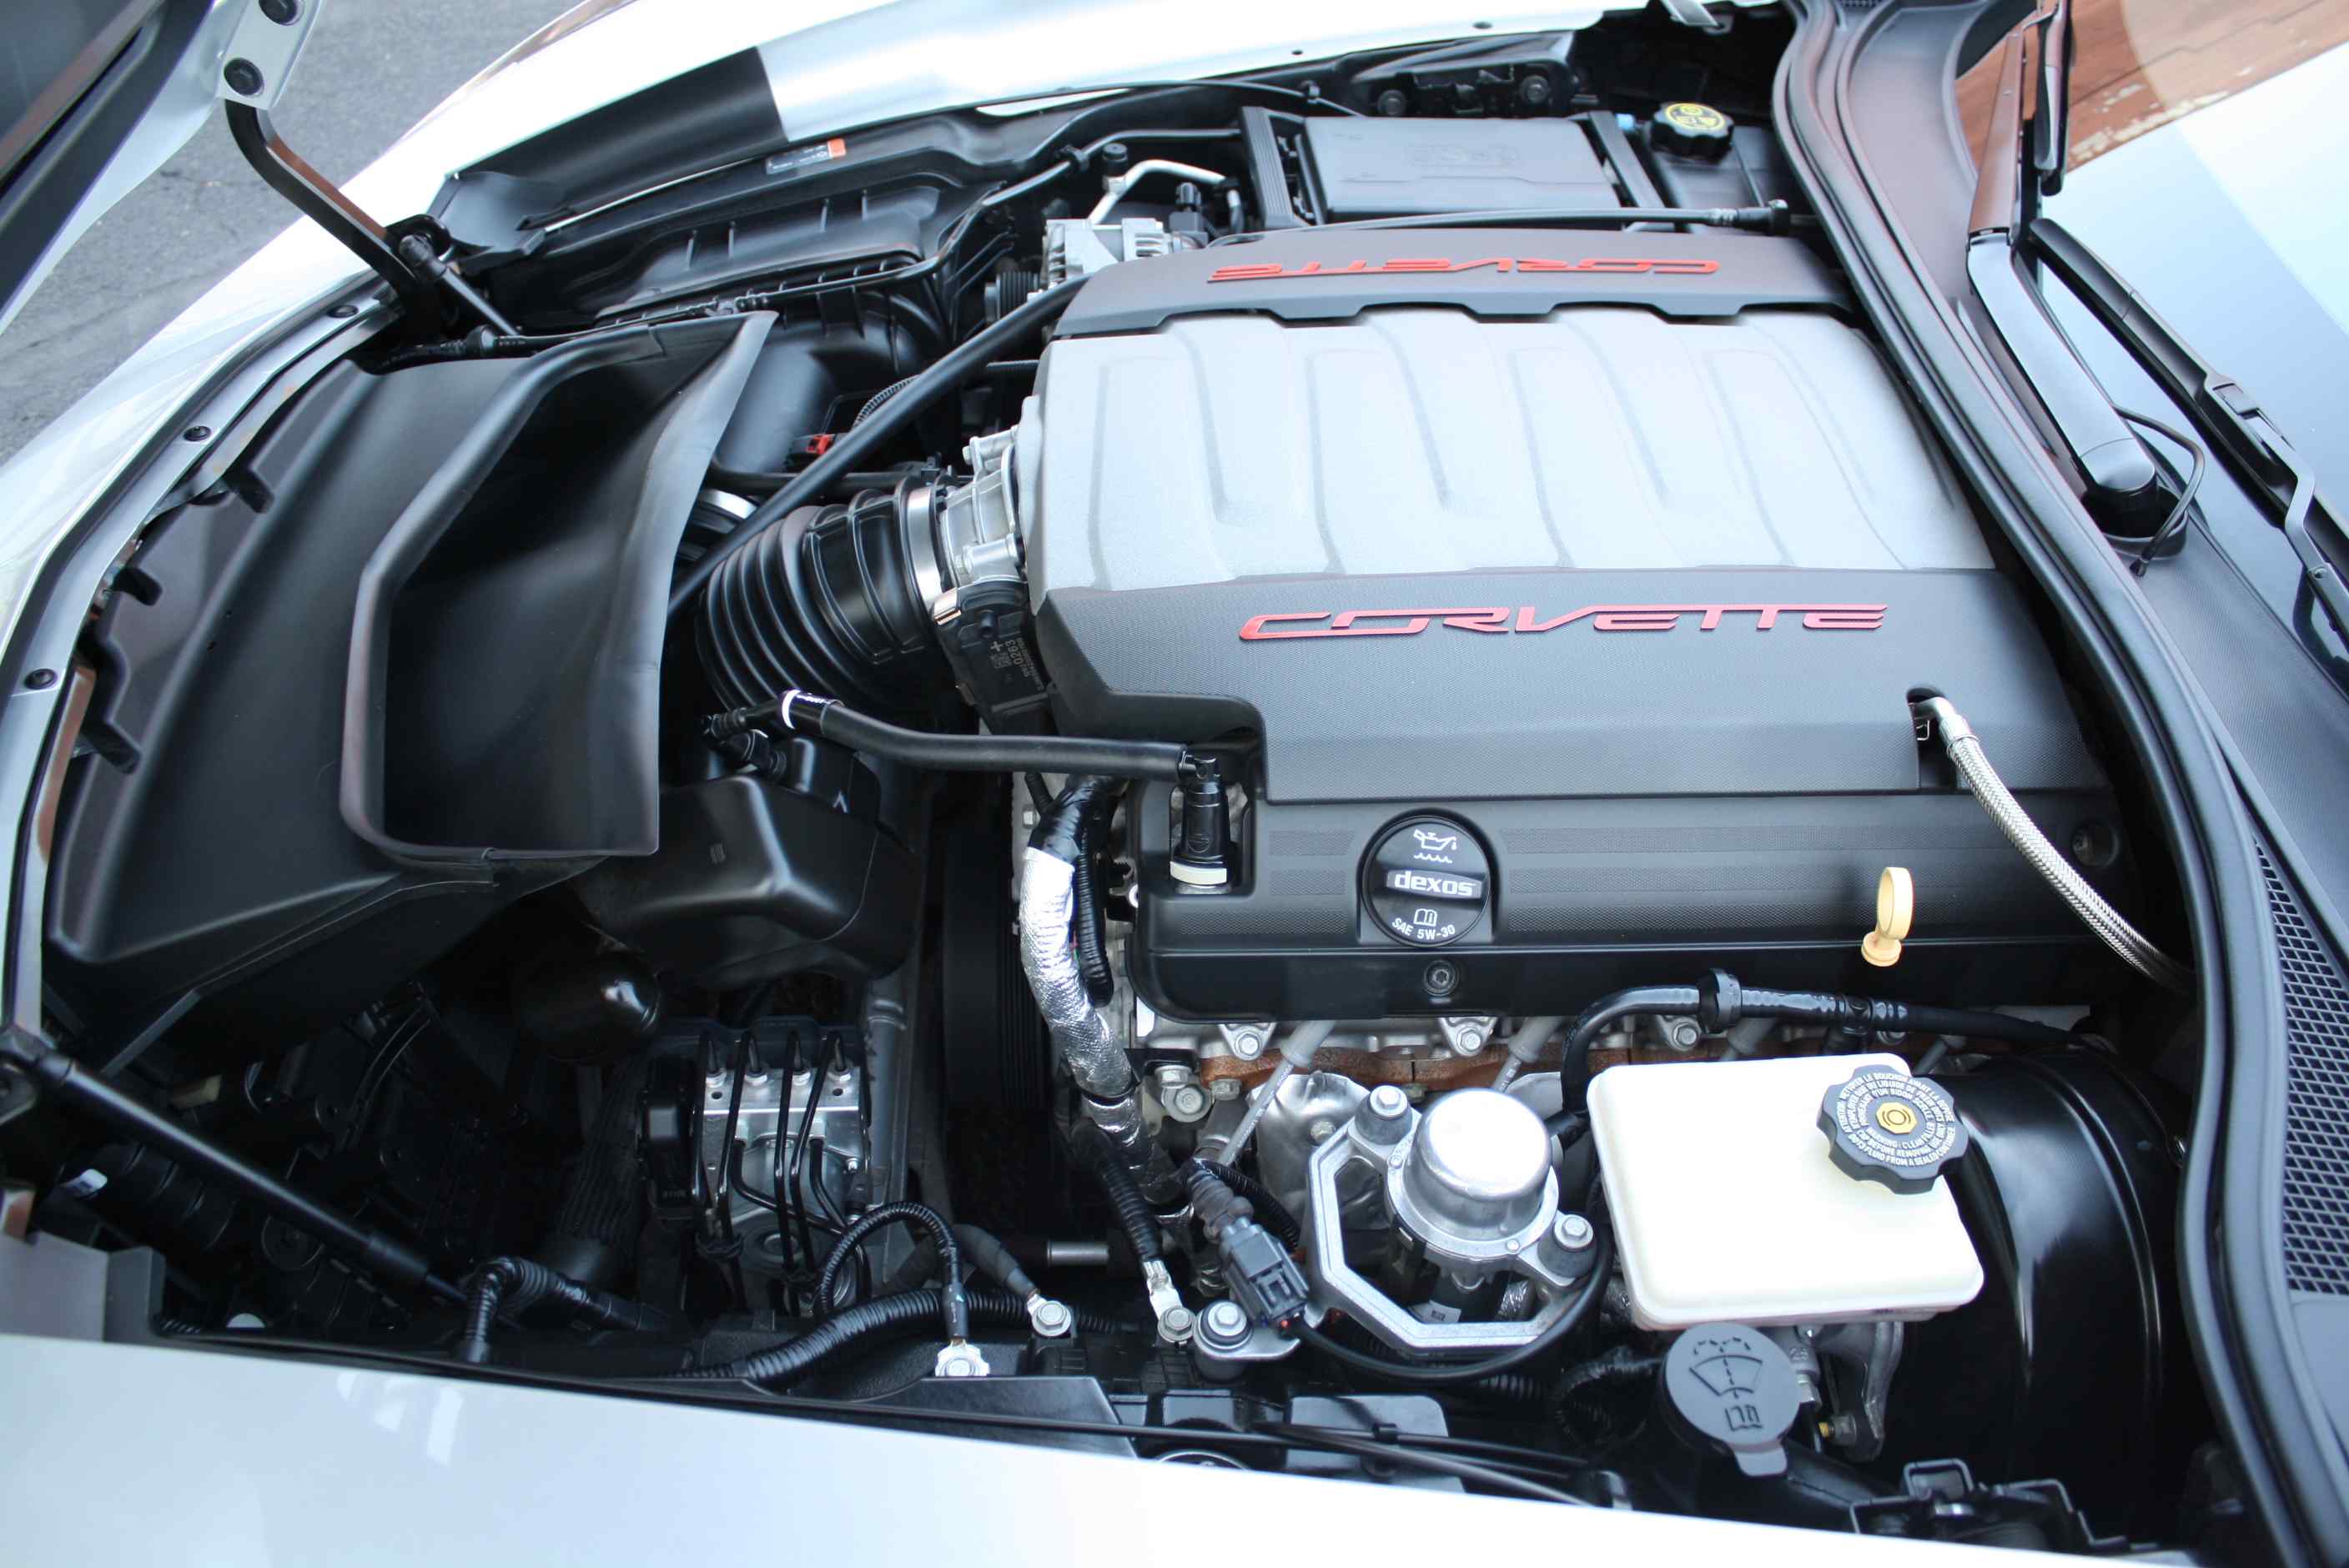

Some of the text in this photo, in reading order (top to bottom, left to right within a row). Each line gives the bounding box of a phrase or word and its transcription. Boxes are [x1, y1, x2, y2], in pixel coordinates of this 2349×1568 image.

[1209, 259, 1718, 282] CORVETTE
[1239, 603, 1889, 641] CORVETTE
[1394, 871, 1476, 896] dexos
[1392, 917, 1455, 940] SAE 5W-30
[1861, 1073, 1874, 1082] LE
[1929, 1090, 1941, 1100] LA
[1865, 1081, 1878, 1090] DU
[1905, 1083, 1917, 1093] DE
[1856, 1128, 1871, 1141] CAP
[1866, 1138, 1895, 1155] BEFORE
[1863, 1145, 1885, 1161] FLUID
[1885, 1155, 1908, 1166] FROM
[1908, 1158, 1915, 1166] A
